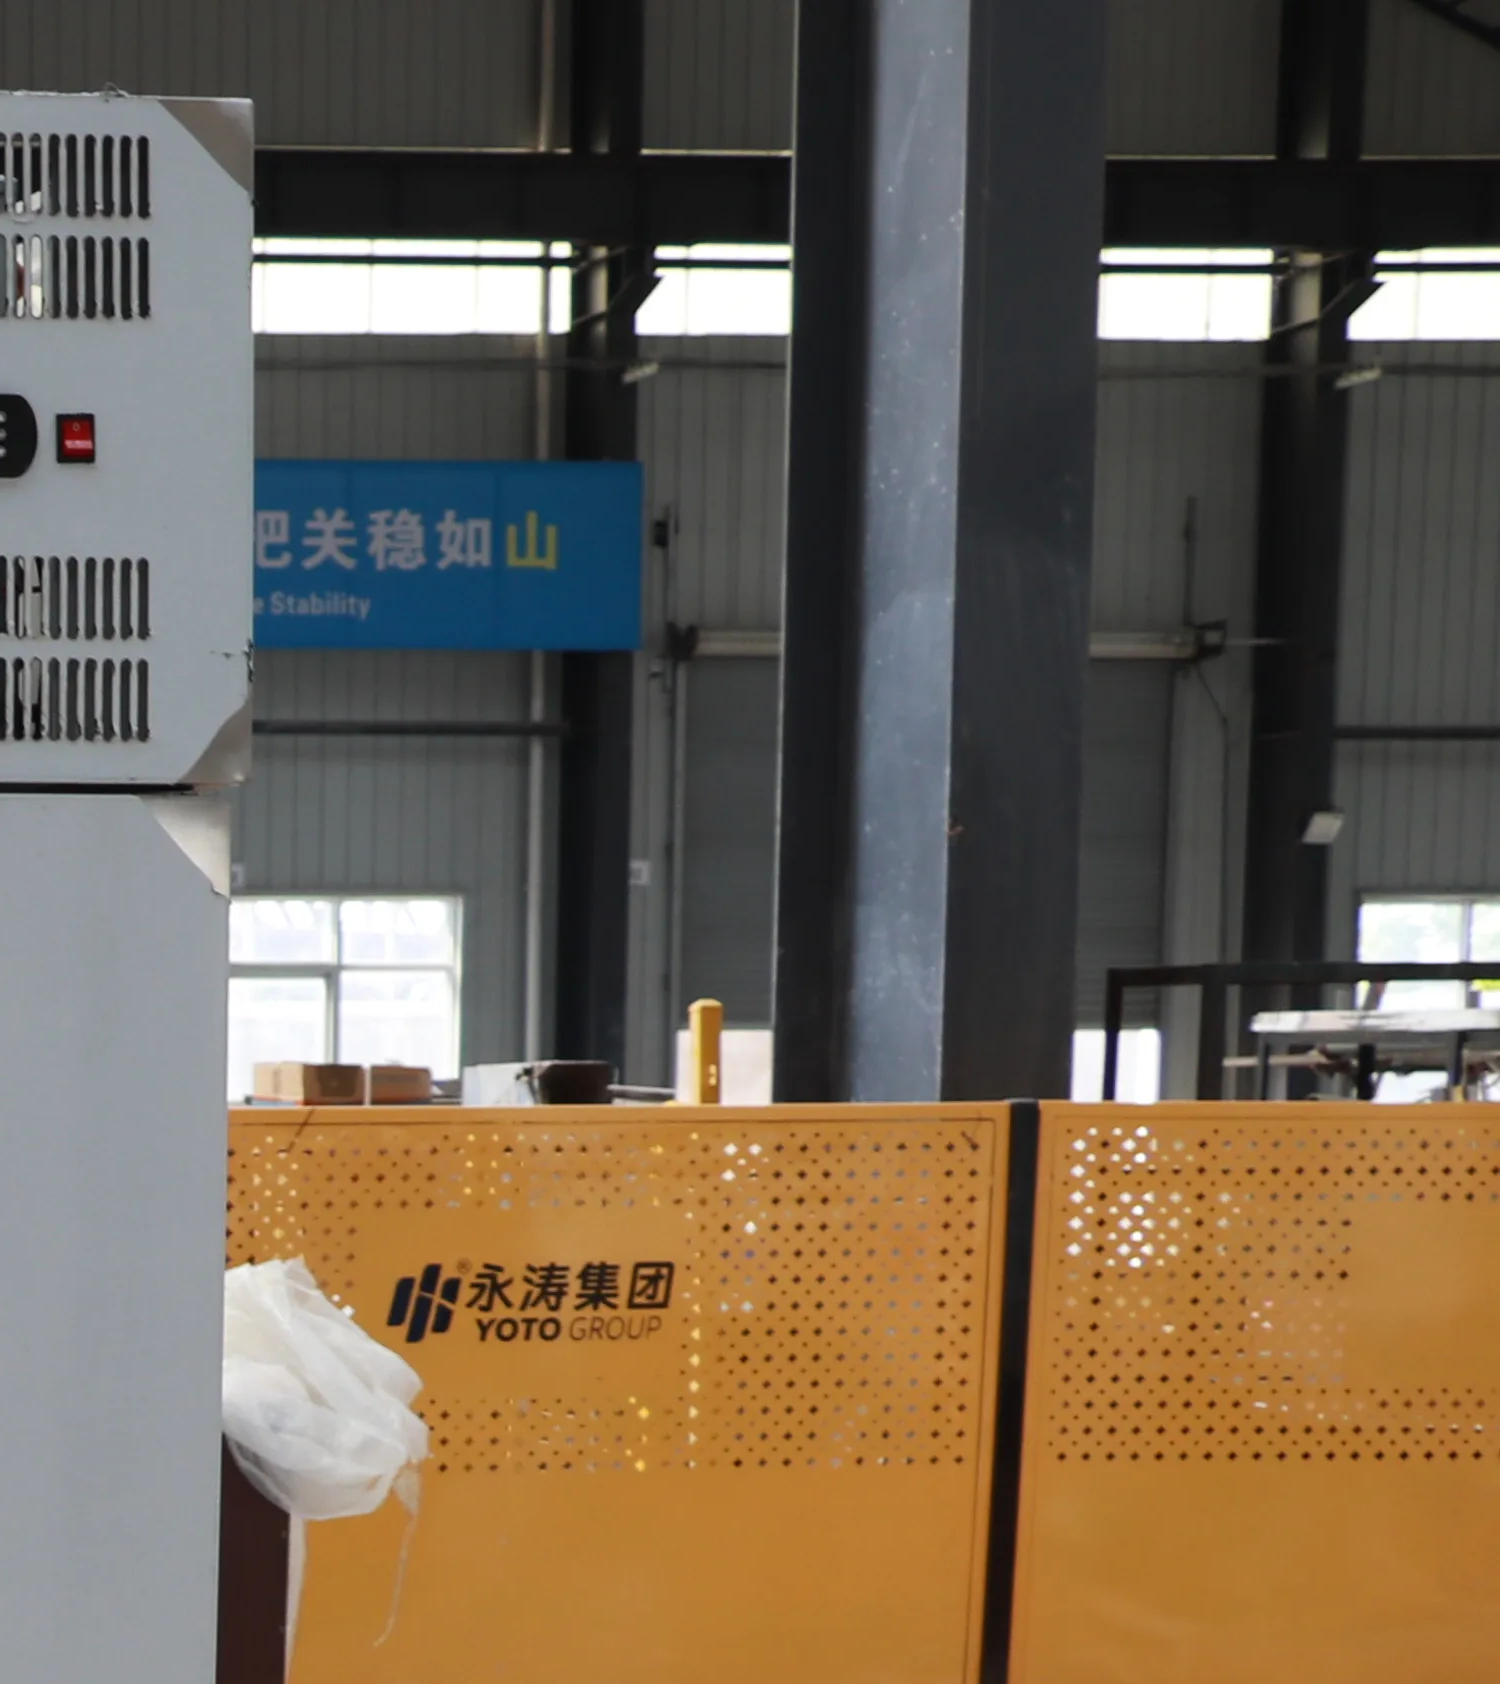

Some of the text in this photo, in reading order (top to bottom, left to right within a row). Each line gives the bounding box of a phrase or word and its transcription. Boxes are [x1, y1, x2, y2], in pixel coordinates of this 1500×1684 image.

[270, 591, 371, 621] Stability
[465, 1260, 675, 1313] 永涛集团
[475, 1315, 663, 1342] YOTO GROUP
